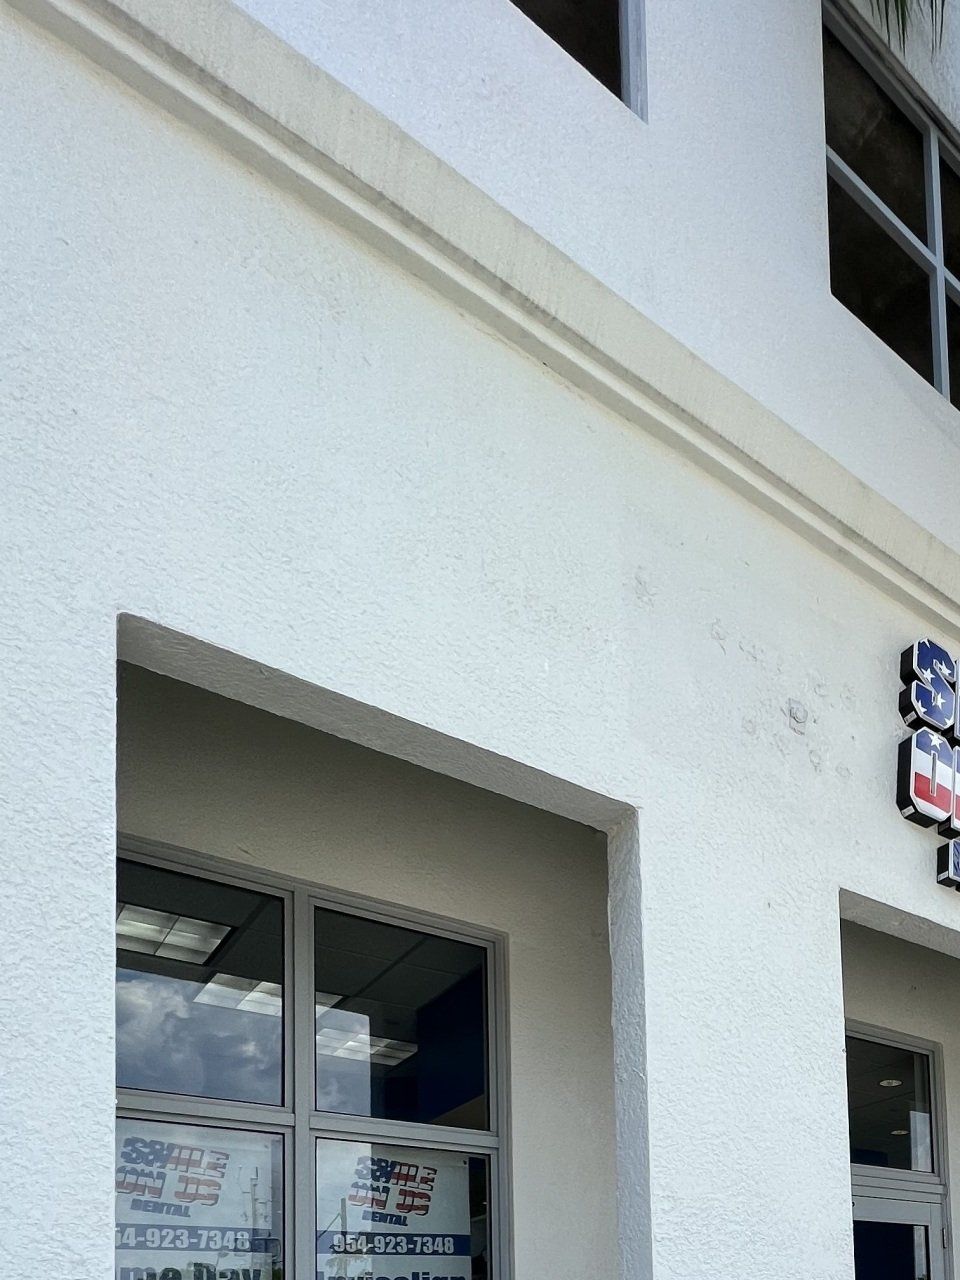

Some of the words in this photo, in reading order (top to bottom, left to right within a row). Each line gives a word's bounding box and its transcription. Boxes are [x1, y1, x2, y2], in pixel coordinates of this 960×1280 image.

[120, 1135, 230, 1179] SMILE
[354, 1156, 438, 1191] SMILE
[174, 1174, 222, 1206] US
[130, 1198, 191, 1218] DENTAL
[333, 1234, 455, 1254] 954-923-7348
